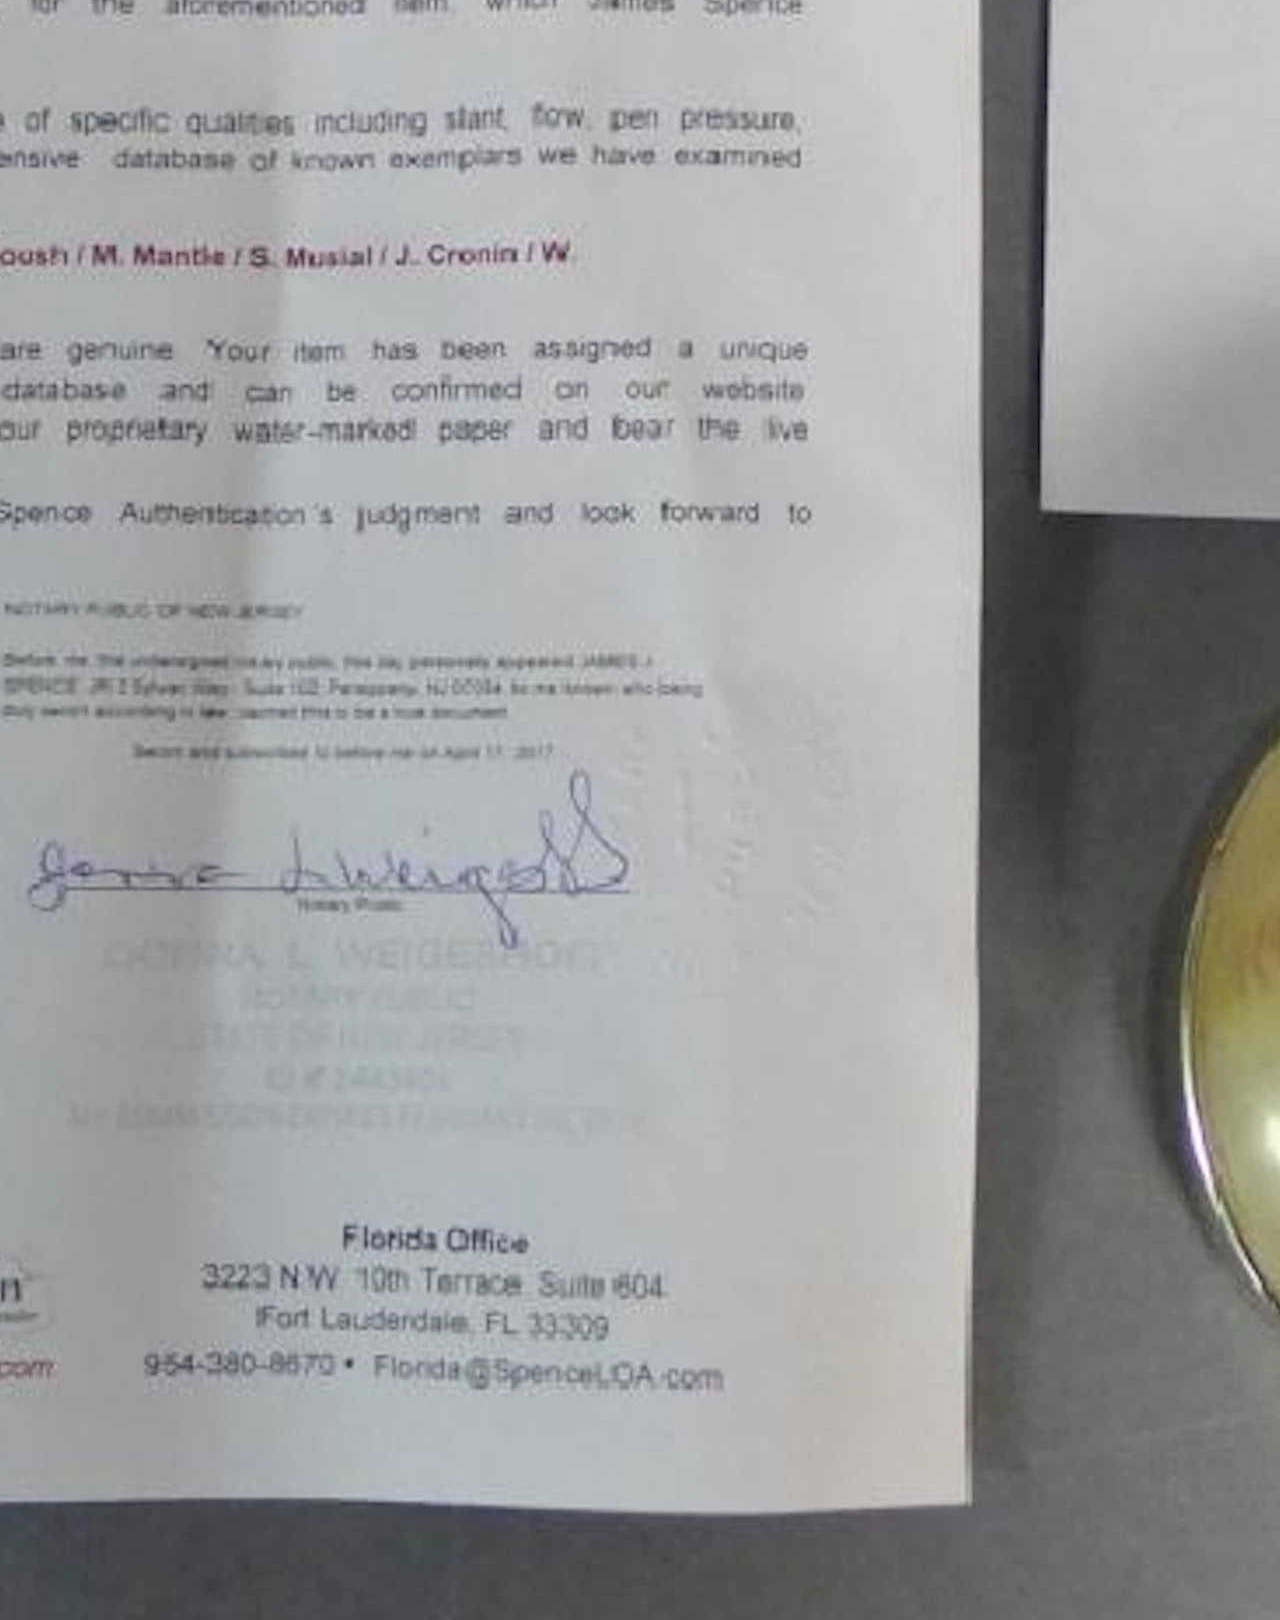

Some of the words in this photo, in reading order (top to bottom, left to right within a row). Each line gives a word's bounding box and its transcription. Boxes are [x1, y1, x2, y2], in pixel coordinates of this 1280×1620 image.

[342, 1223, 439, 1253] Florida
[444, 1226, 530, 1255] Office
[254, 1303, 311, 1332] Fort
[479, 1308, 522, 1342] FL
